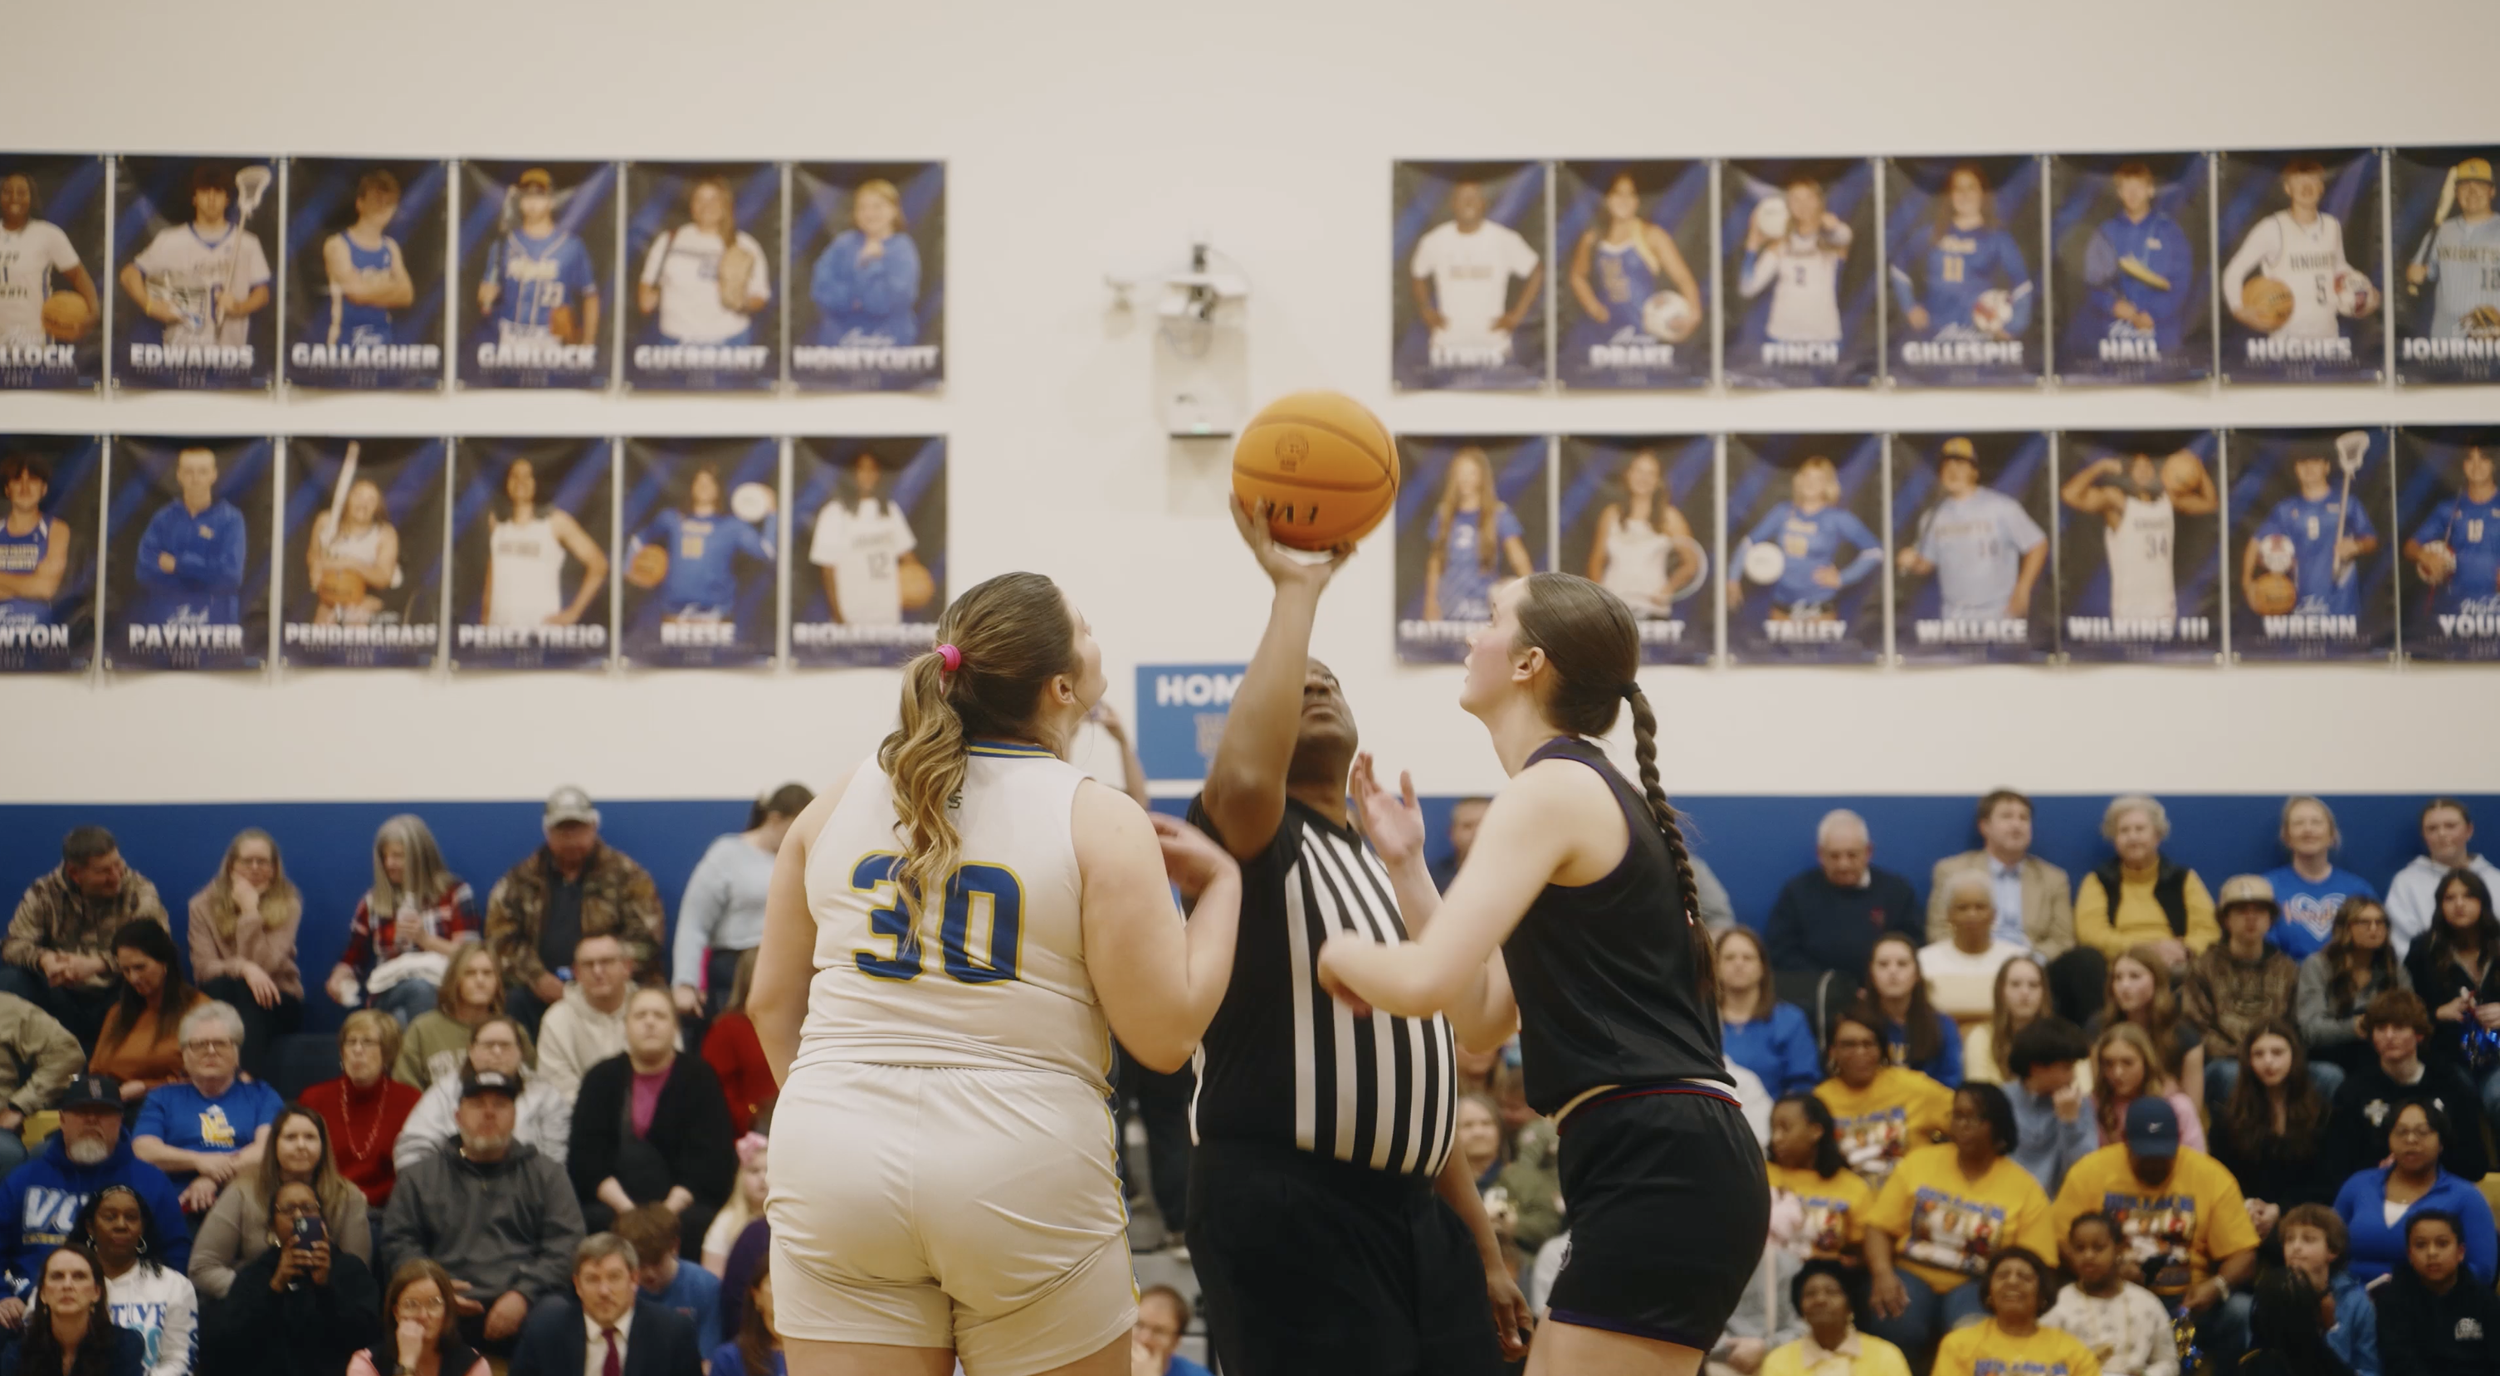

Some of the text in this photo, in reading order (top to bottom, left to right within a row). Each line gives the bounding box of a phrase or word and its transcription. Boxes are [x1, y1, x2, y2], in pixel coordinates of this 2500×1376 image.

[2315, 274, 2328, 307] 5
[130, 343, 254, 368] EDWARDS
[292, 343, 440, 368] GALLAGHER
[477, 343, 596, 368] GARLOCK
[634, 345, 769, 369] GUERRANT
[793, 345, 939, 370] HONEYCUTT
[1589, 344, 1674, 367] DRAKE
[1761, 342, 1839, 366] FINCH
[1901, 341, 2024, 365] GILLESPIE
[2099, 338, 2160, 363] HALL
[2246, 337, 2352, 361] HUGHES
[128, 624, 243, 649] PAYNTER
[285, 623, 438, 647] PENDERGRASS
[458, 623, 606, 648] PEREZ TREJO
[661, 622, 735, 647] REESE
[1764, 619, 1847, 643] TALLEY
[1915, 618, 2028, 644] WALLACE
[2068, 616, 2209, 641] WILKINS III
[2263, 614, 2357, 640] WRENN
[2439, 614, 2500, 640] YOU
[1155, 673, 1246, 707] HOM
[848, 849, 1026, 986] 30
